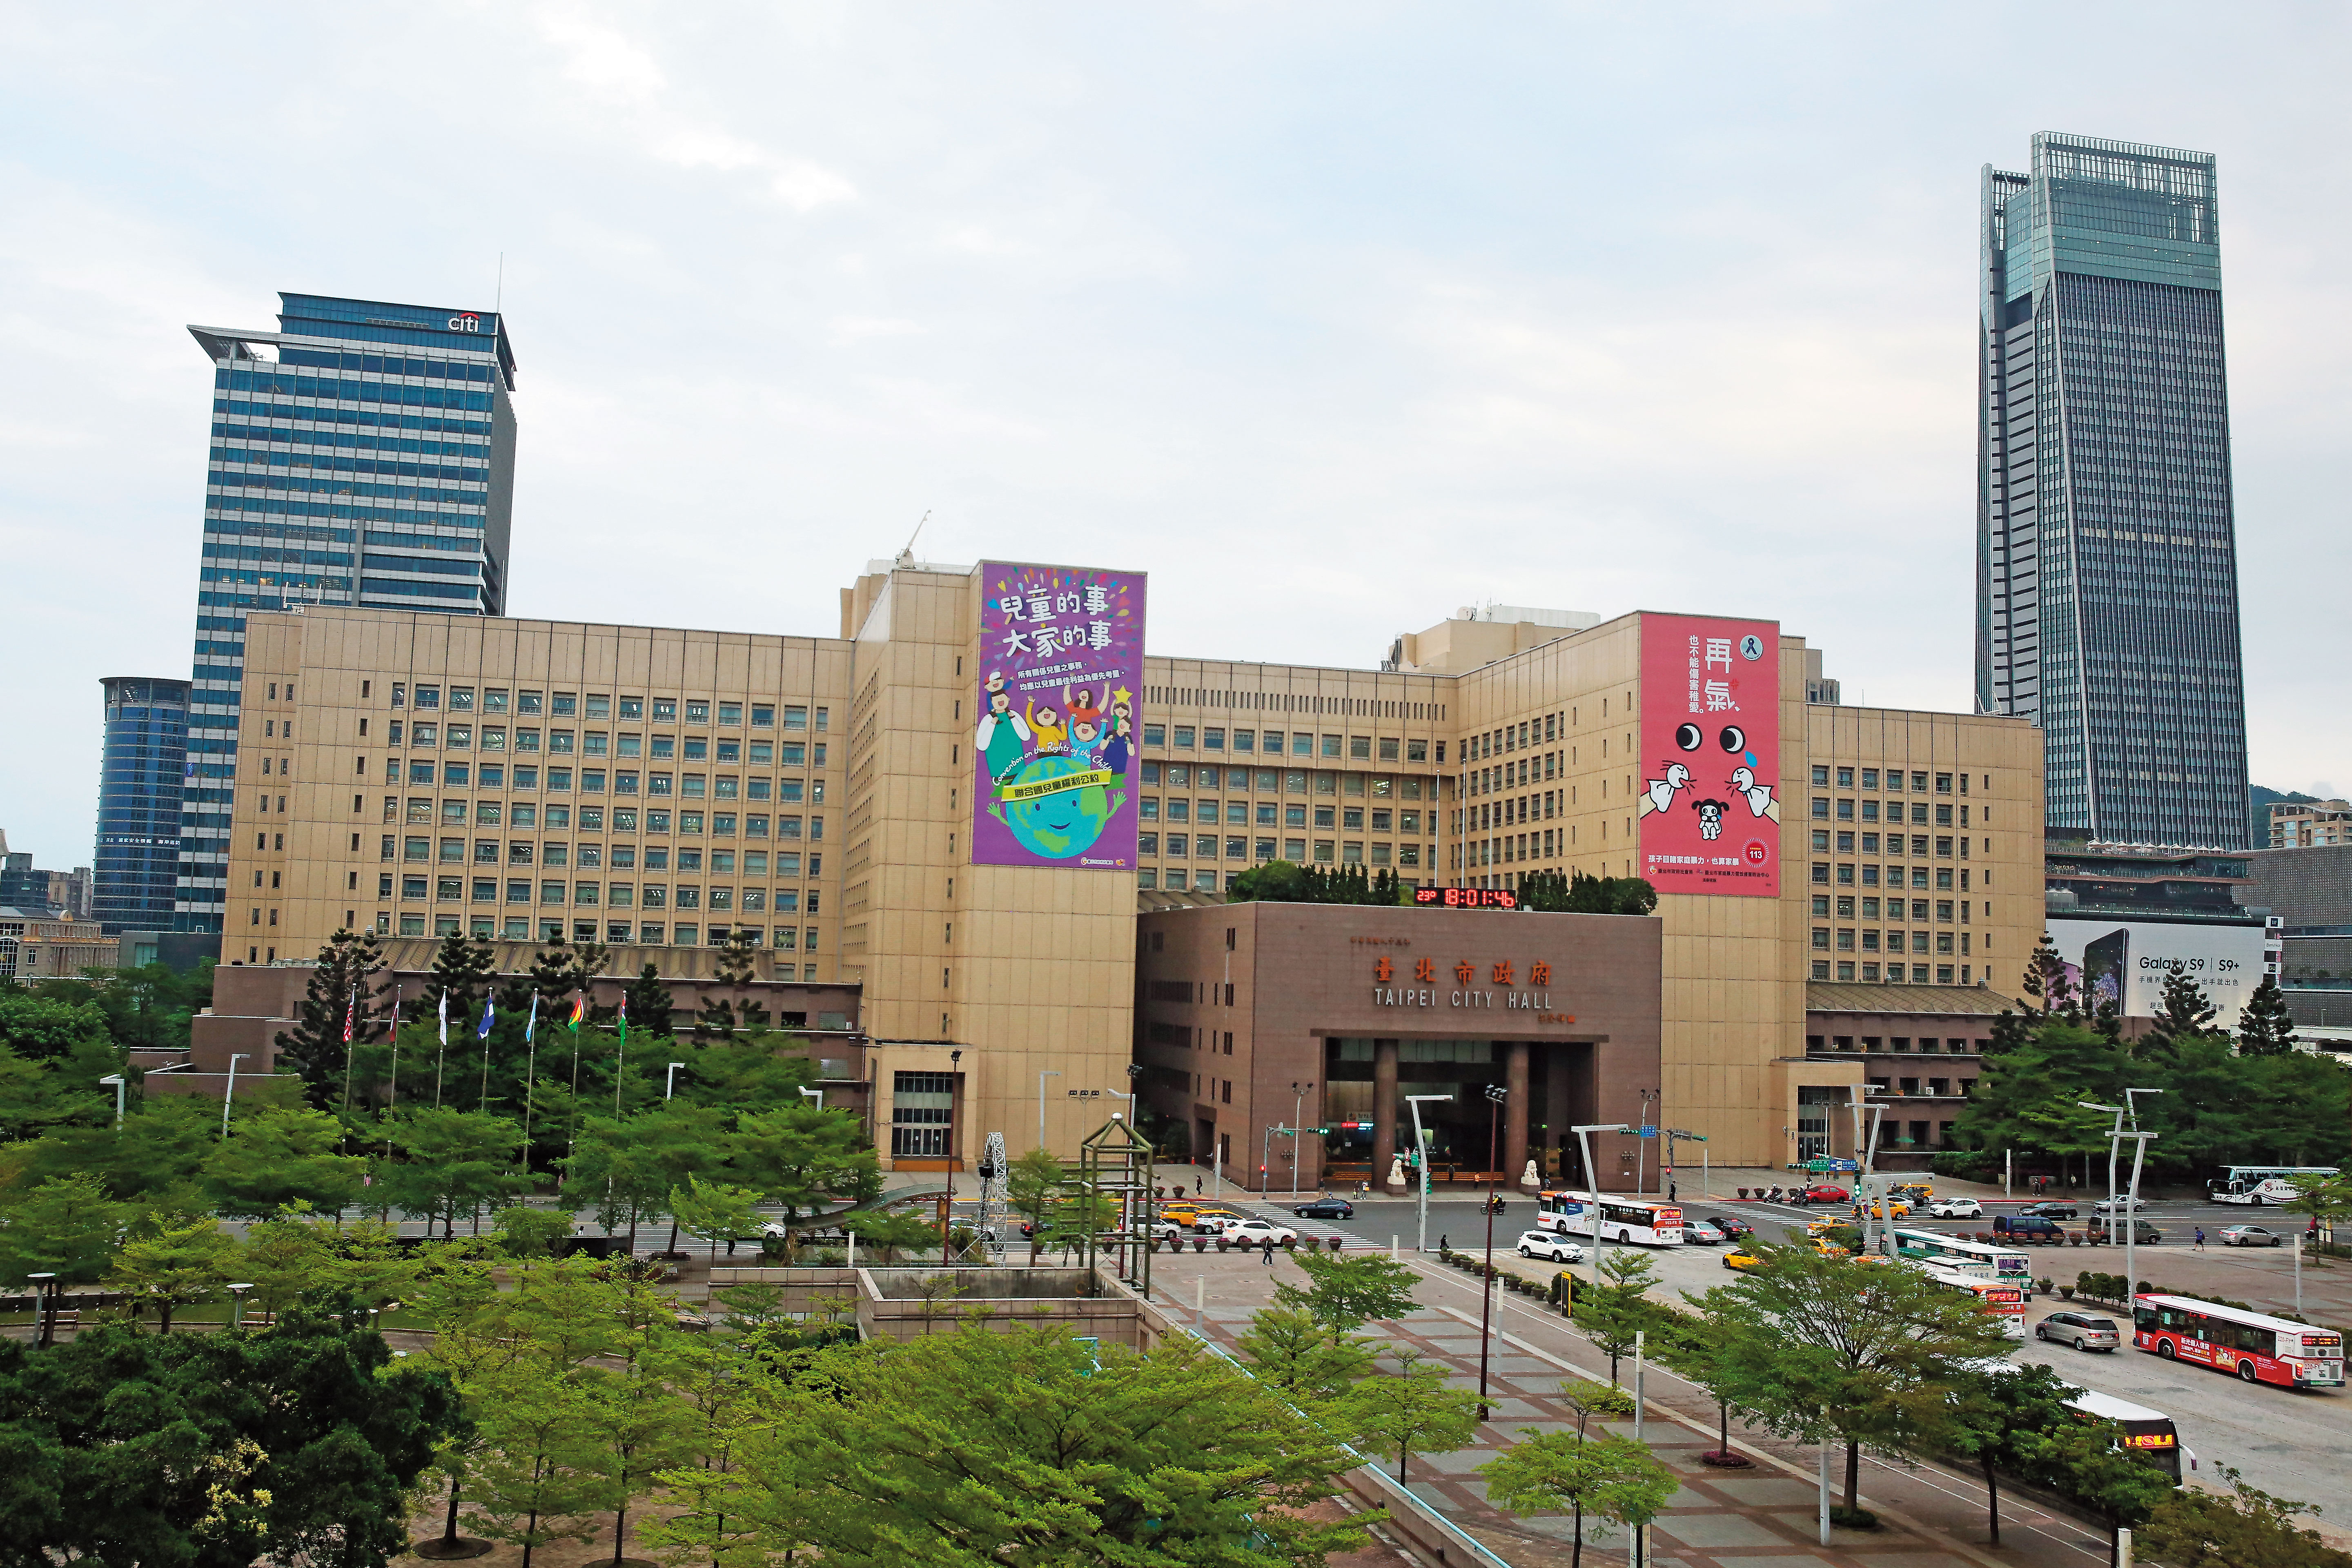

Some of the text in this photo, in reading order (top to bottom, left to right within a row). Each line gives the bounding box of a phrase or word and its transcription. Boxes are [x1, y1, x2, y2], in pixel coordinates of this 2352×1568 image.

[448, 316, 479, 332] citi
[1000, 583, 1109, 623] 兒童的事
[1002, 619, 1113, 658] 大家的事
[992, 741, 1111, 786] Convention on the Rights of the Child
[1015, 774, 1099, 797] 聯合國兒童權利公約
[1749, 850, 1762, 859] 113
[1444, 888, 1515, 908] 18:01:46
[1374, 956, 1552, 986] 臺北市政府
[2139, 956, 2239, 972] Galaxy S9 S9+
[1375, 988, 1552, 1009] TAIPEI CITY HALL
